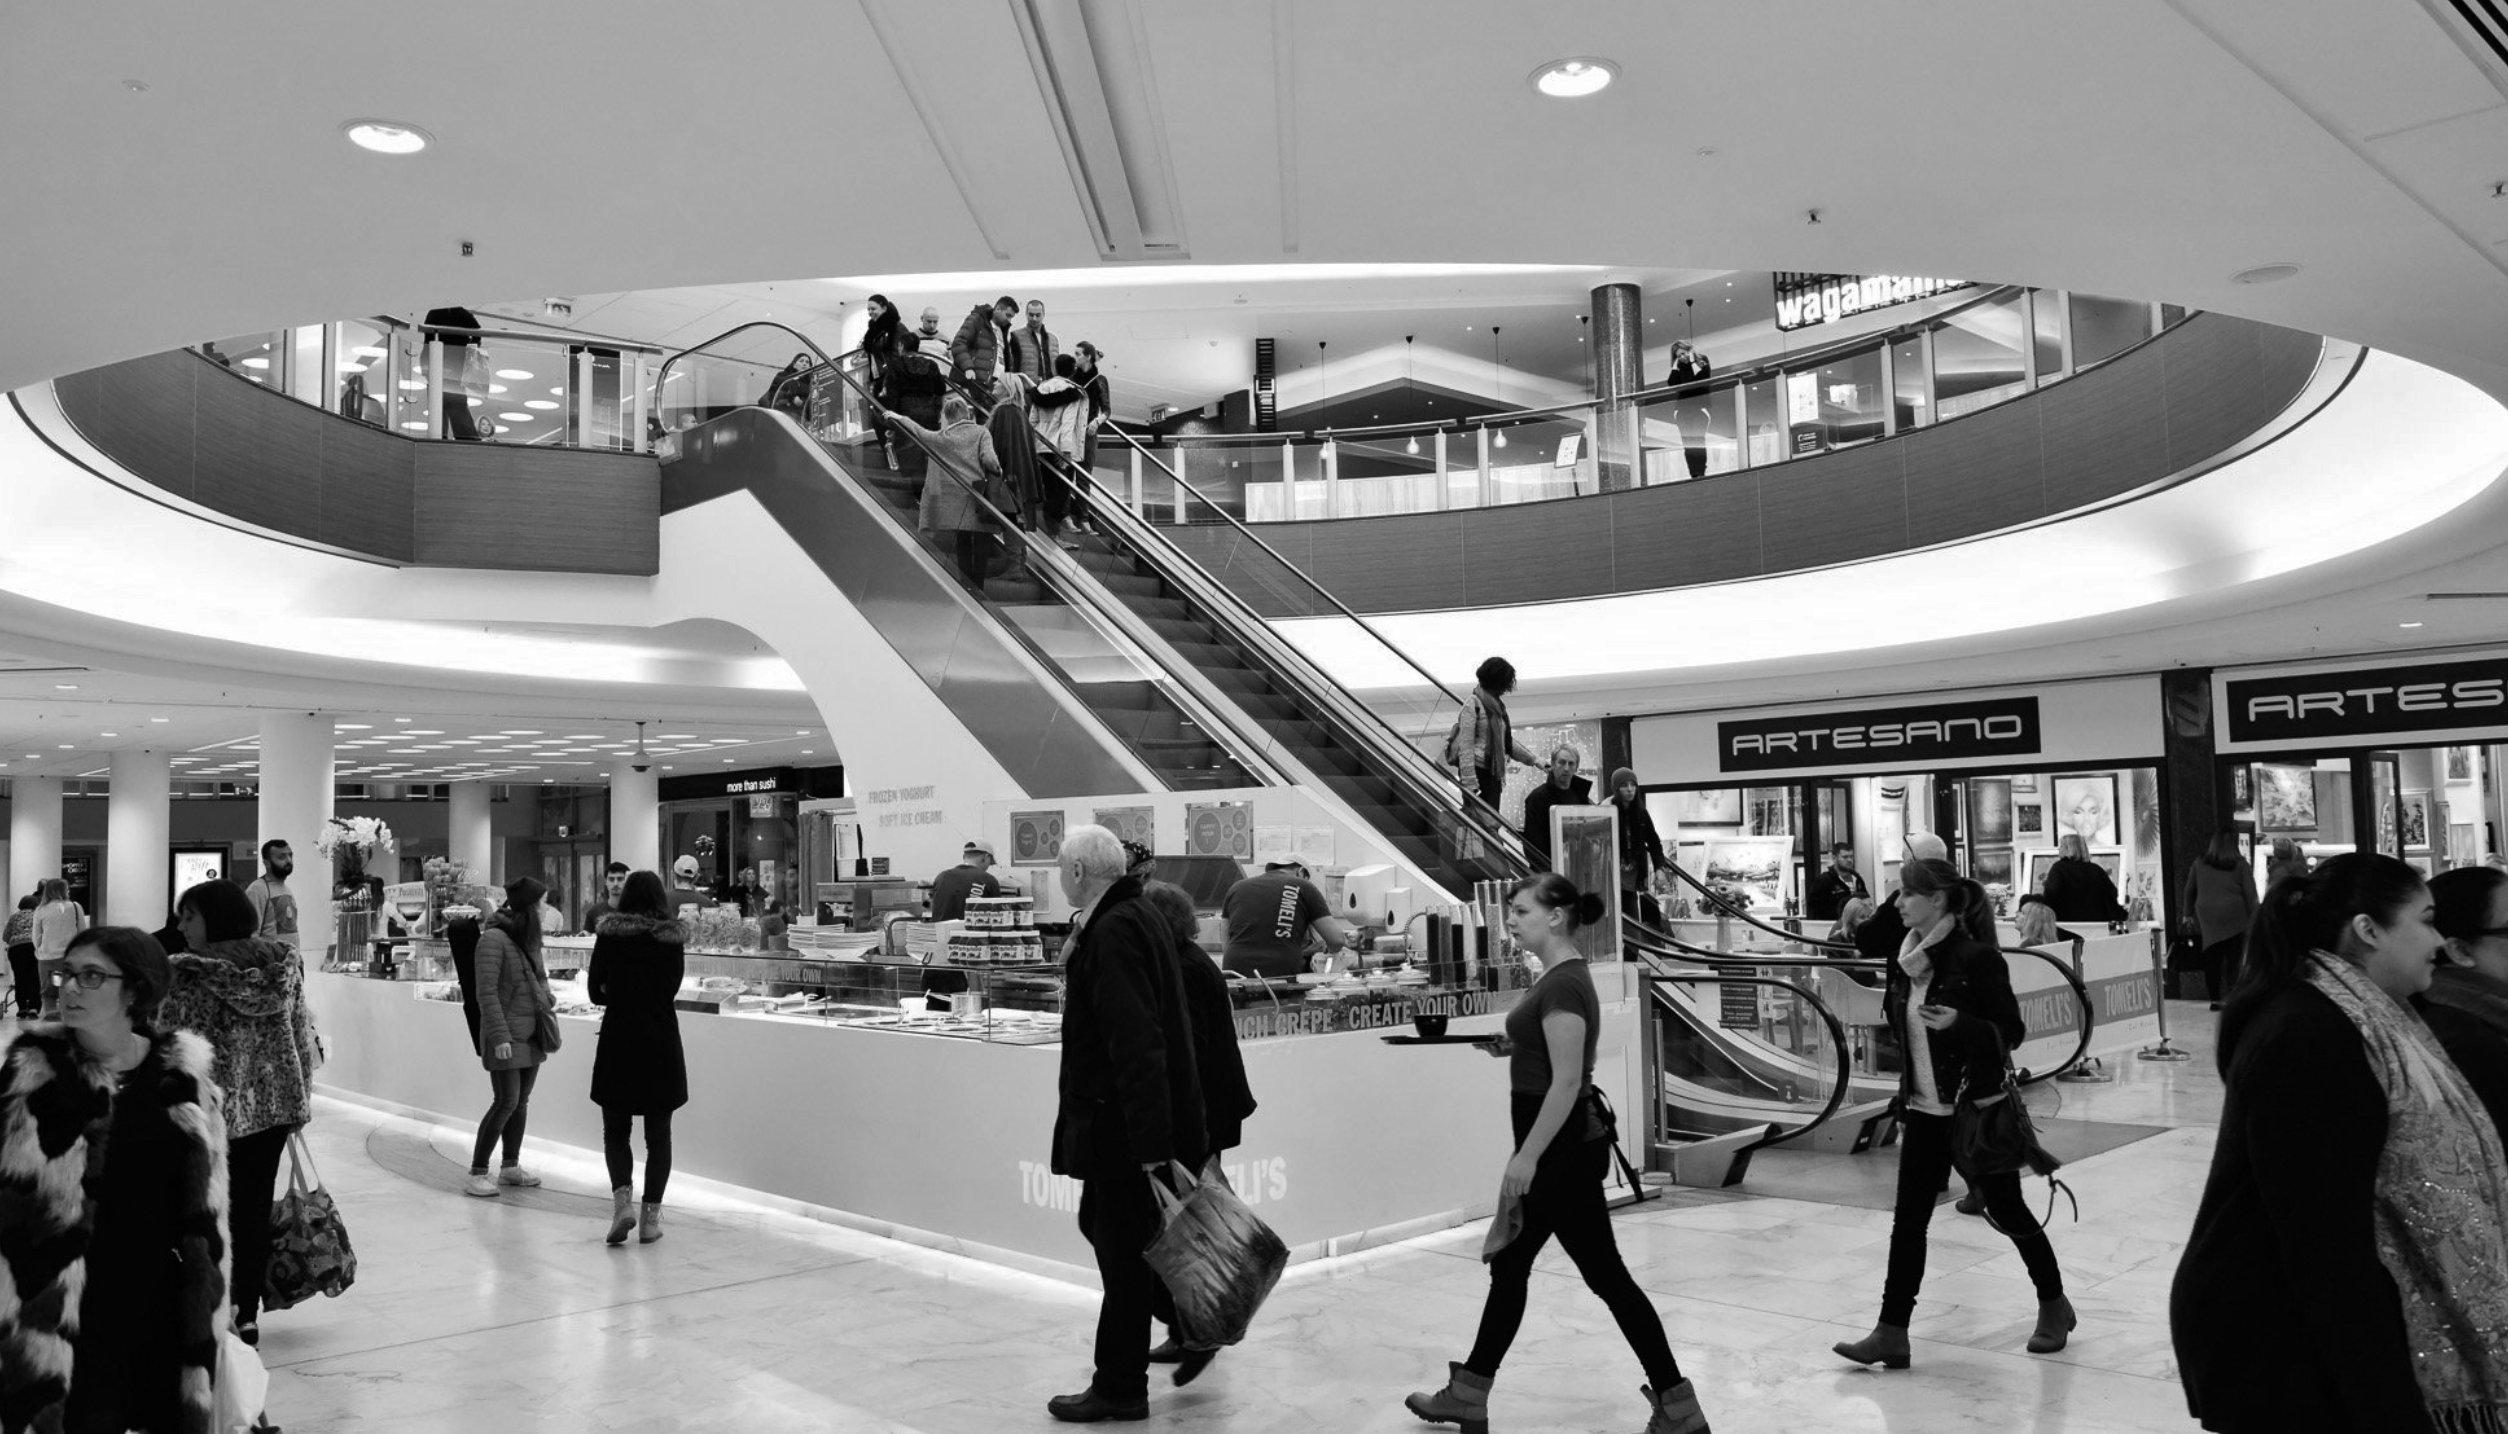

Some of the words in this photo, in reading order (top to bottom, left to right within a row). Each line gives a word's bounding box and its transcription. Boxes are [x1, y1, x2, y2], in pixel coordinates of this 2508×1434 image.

[2248, 678, 2508, 722] ARTES
[1732, 714, 2023, 757] ARTESANO
[726, 782, 743, 793] more
[743, 780, 758, 791] than
[759, 776, 777, 790] sushi
[868, 788, 898, 804] FROZEN
[914, 810, 943, 826] CREAM
[1274, 884, 1301, 939] TOMELI'S
[781, 966, 801, 982] YOUR
[803, 968, 822, 984] OWN
[1274, 1007, 1335, 1036] CREPE
[1349, 1000, 1413, 1030] CREATE
[1416, 995, 1458, 1018] YOUR
[2104, 975, 2152, 1018] TOMELI'S
